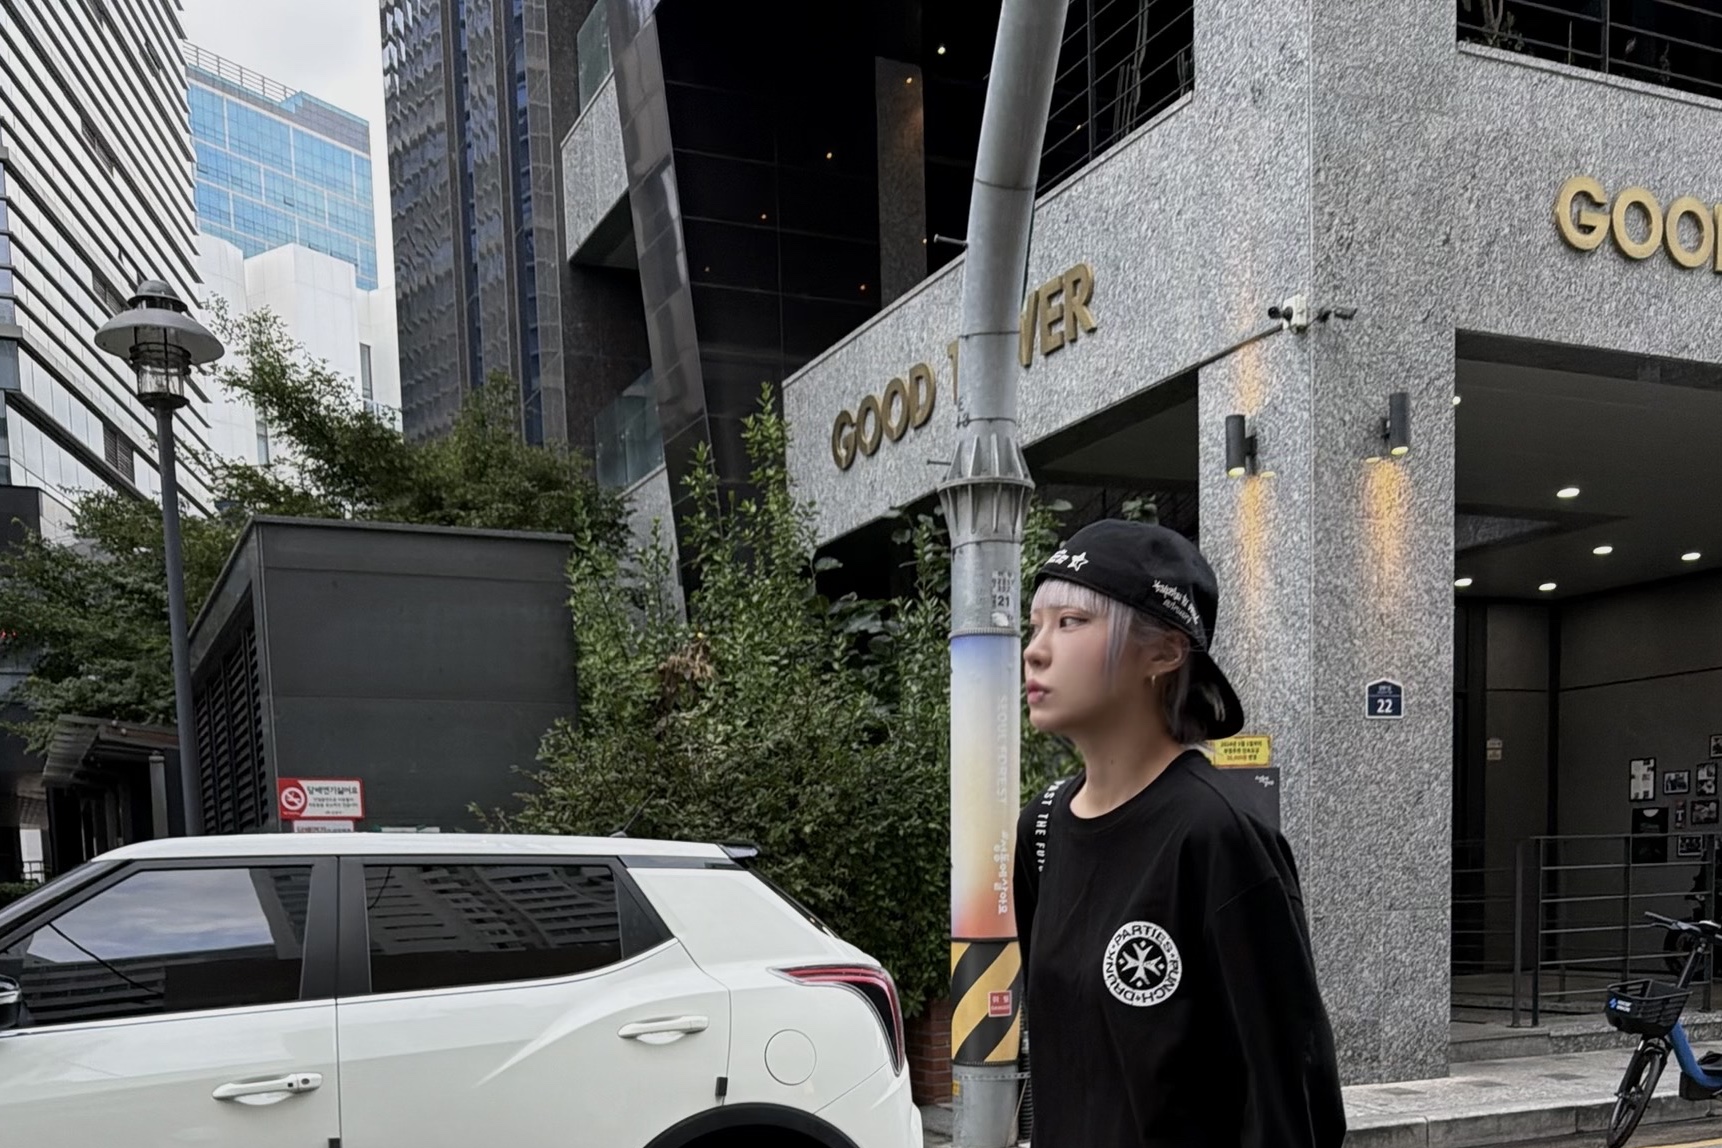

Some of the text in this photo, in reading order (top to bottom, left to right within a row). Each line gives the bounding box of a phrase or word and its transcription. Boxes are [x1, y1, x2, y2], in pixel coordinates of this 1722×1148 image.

[1557, 175, 1722, 274] GOO
[832, 262, 1097, 471] GOOD TER
[1377, 699, 1393, 713] 22
[1034, 812, 1050, 836] THE
[1114, 924, 1174, 954] PARTIES
[1105, 950, 1136, 1002] DRUNK
